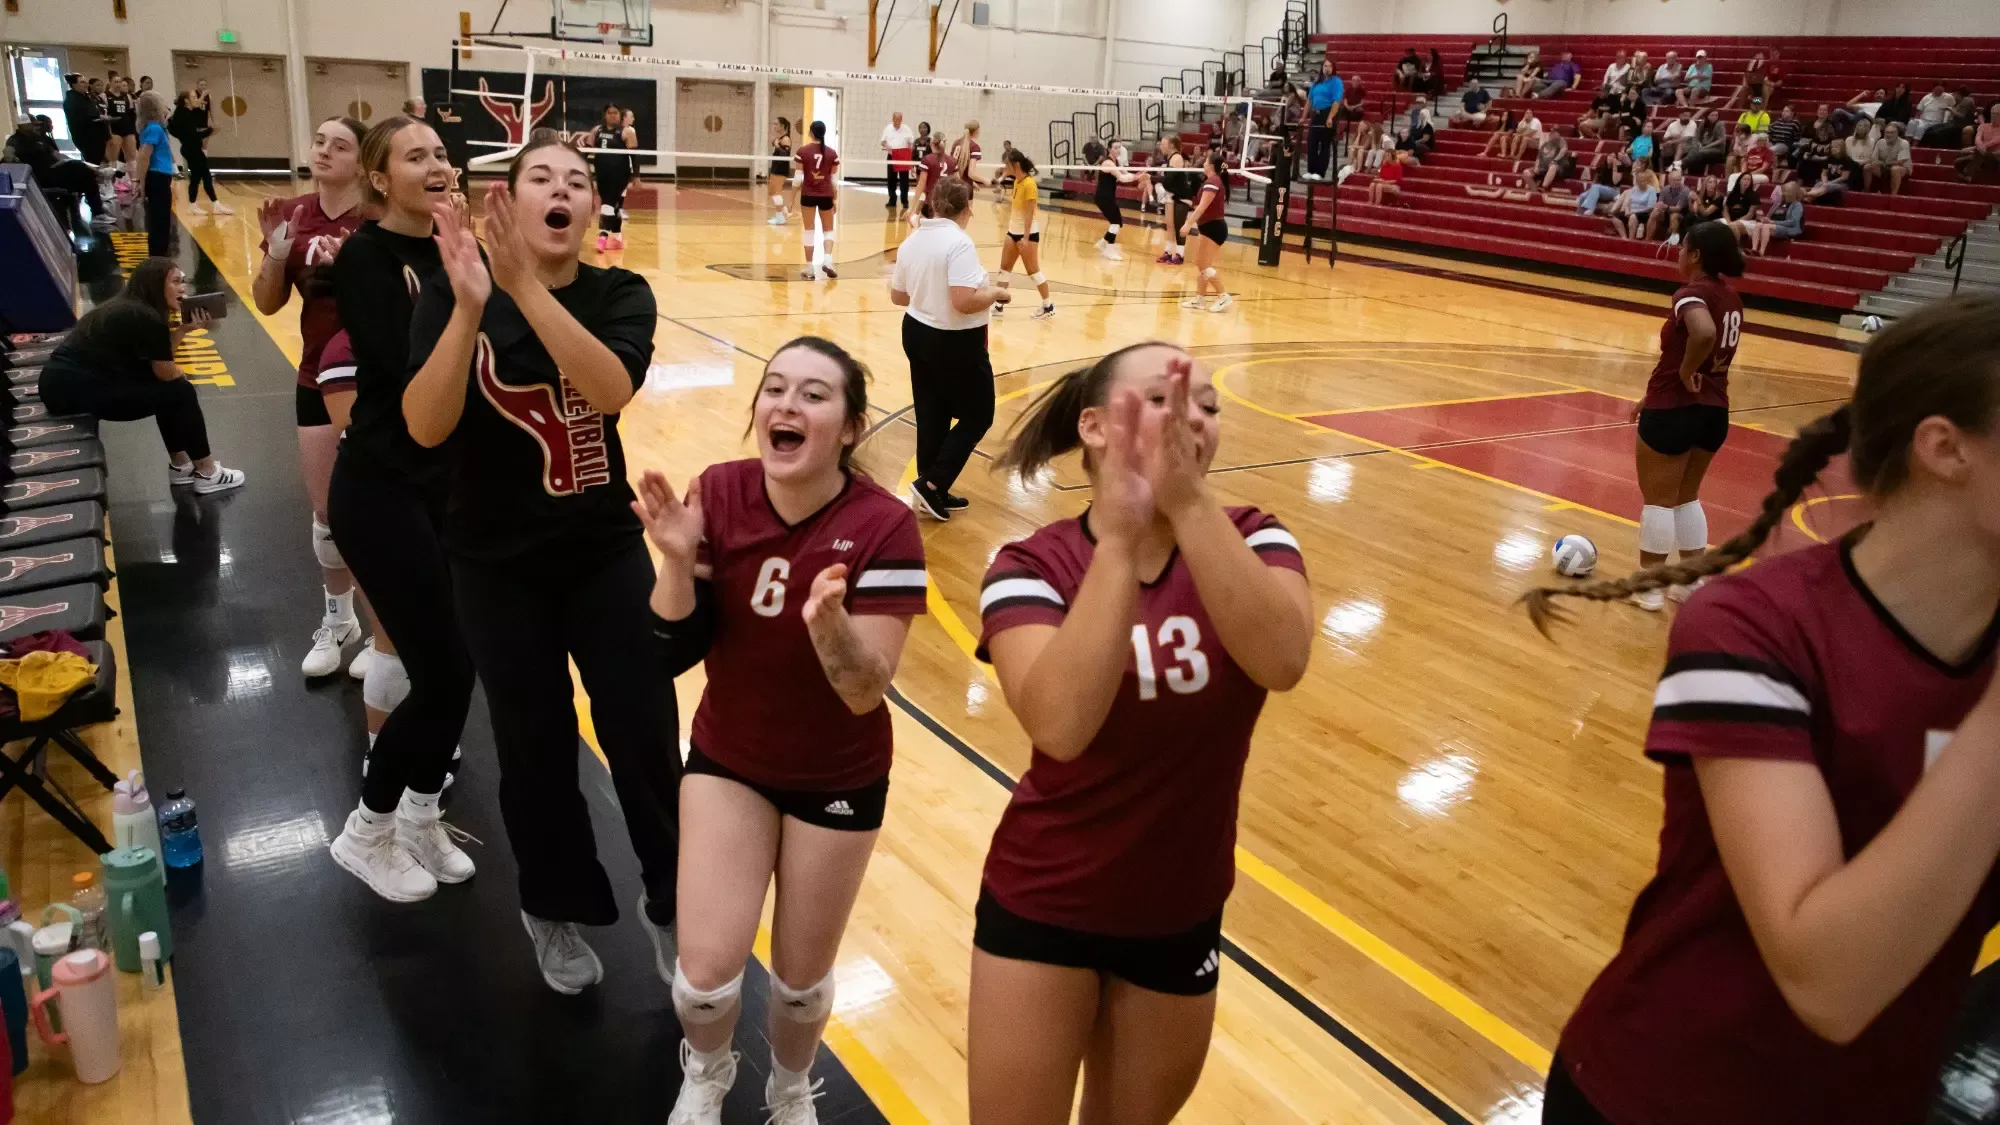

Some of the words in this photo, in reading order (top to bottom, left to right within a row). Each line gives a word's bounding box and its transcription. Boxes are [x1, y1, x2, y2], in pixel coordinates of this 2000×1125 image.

[573, 51, 606, 60] YAKIMA
[611, 55, 642, 63] VALLEY
[646, 57, 681, 66] COLLEGE
[717, 63, 746, 71] YAKIMA
[782, 68, 814, 76] COLLEGE
[813, 153, 823, 170] 7
[939, 161, 948, 177] 2
[1720, 310, 1741, 349] 18
[750, 556, 791, 617] 6
[1131, 615, 1210, 701] 13
